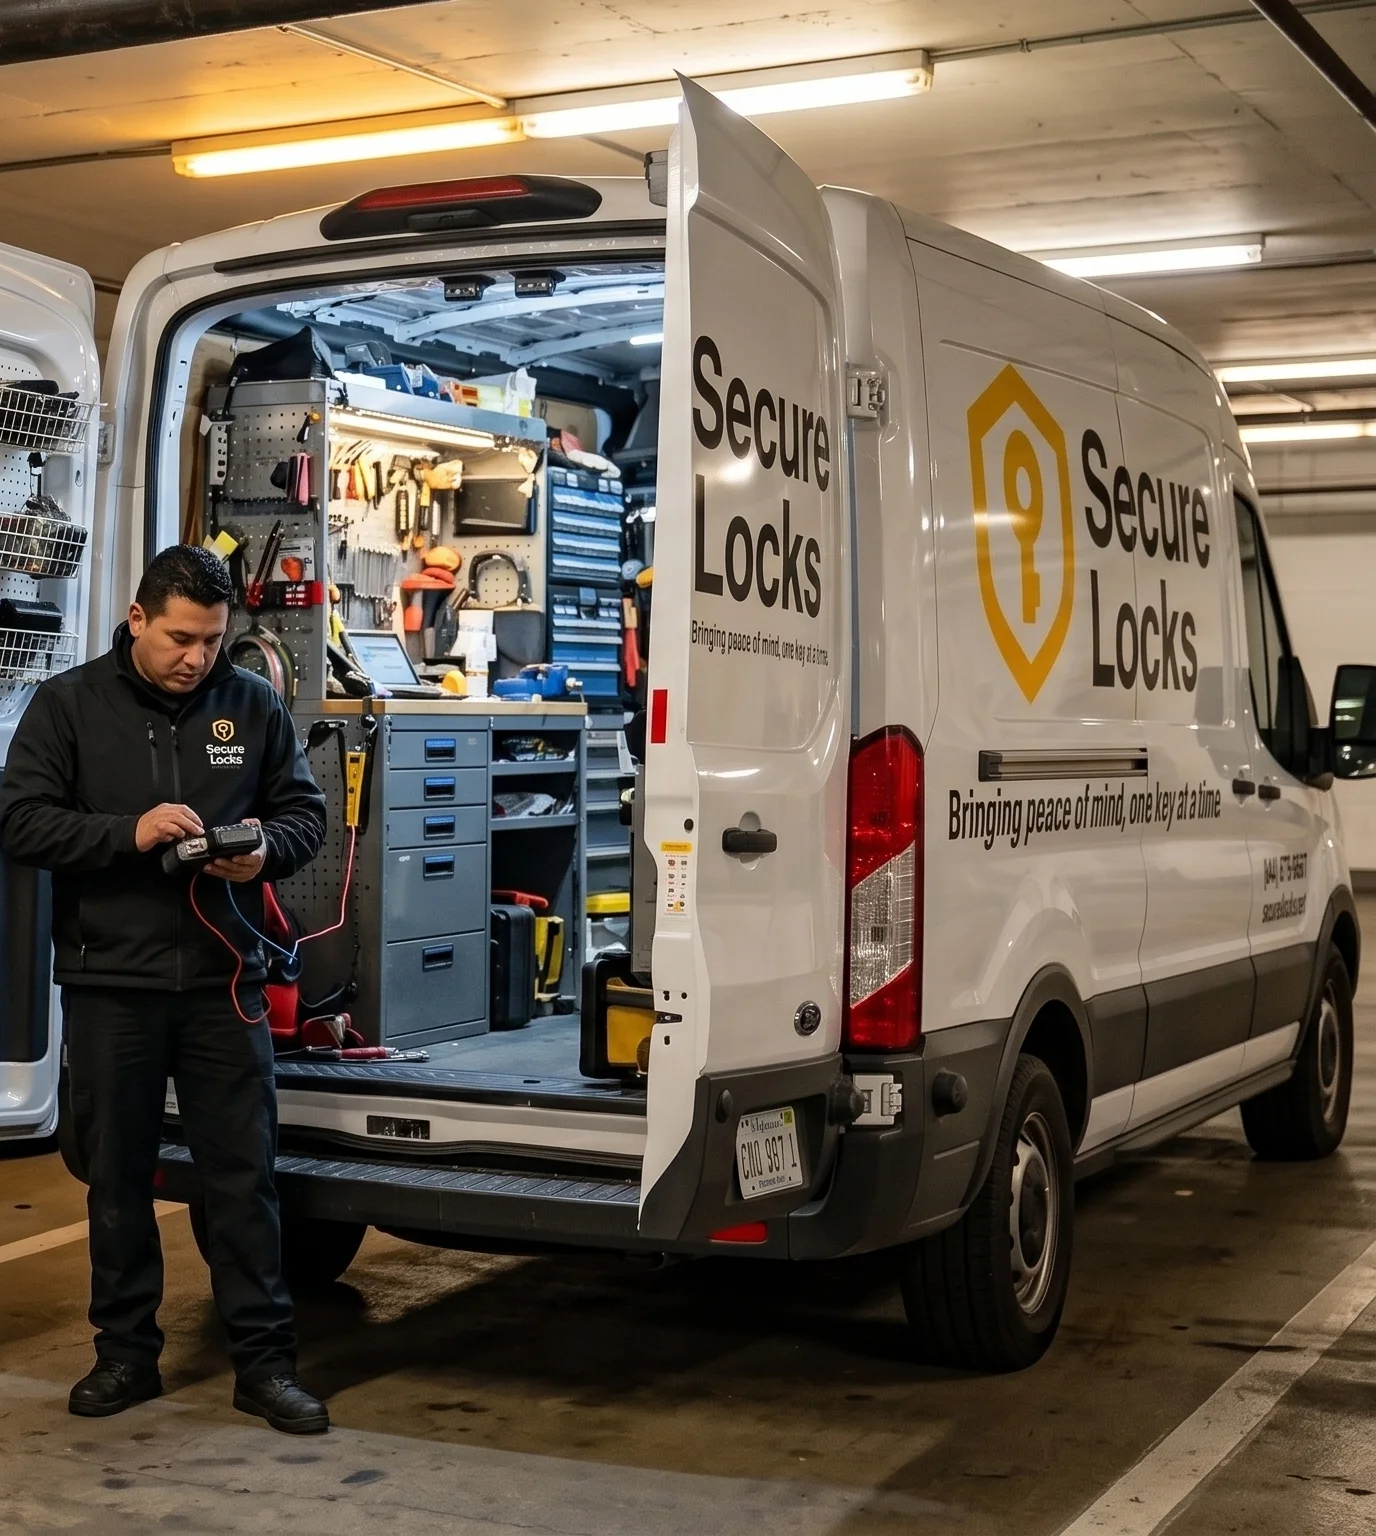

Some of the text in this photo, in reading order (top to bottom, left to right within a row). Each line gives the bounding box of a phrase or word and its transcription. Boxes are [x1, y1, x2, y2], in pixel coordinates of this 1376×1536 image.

[692, 335, 830, 492] Secure
[695, 473, 821, 618] Locks
[1081, 428, 1210, 569] Secure
[691, 620, 726, 655] Bringing
[752, 631, 761, 655] of
[1090, 569, 1198, 693] Locks
[206, 744, 245, 754] Secure
[210, 754, 243, 765] Locks
[948, 780, 1221, 851] Bringing peace of mind, one key at a time
